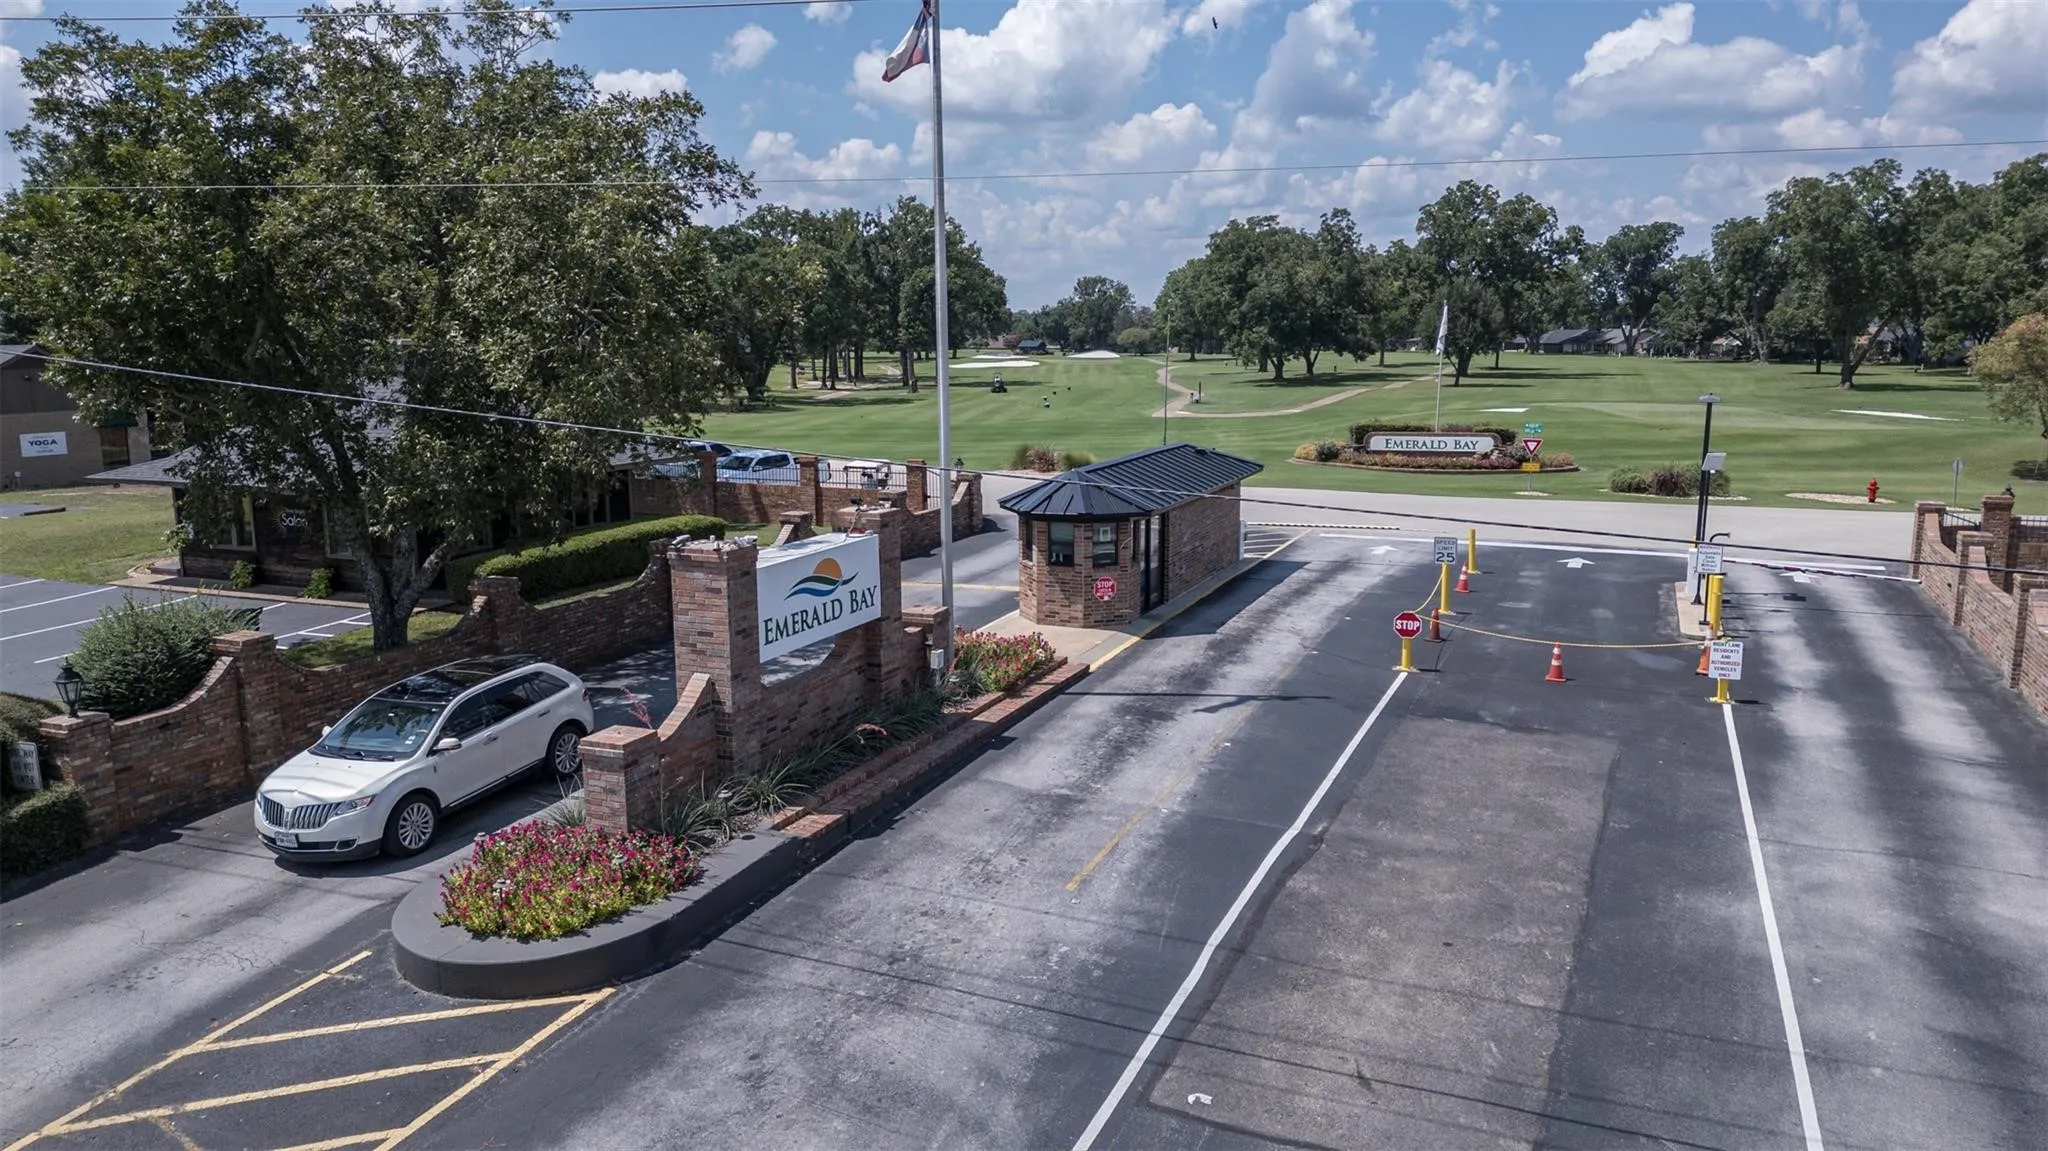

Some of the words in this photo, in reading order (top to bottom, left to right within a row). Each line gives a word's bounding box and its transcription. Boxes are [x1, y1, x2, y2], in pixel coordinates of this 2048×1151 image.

[1385, 438, 1448, 450] EMERALD
[1454, 439, 1479, 450] BAY
[1436, 551, 1455, 562] 25
[1097, 581, 1112, 589] STOP
[763, 598, 843, 646] EMERALD
[849, 585, 878, 614] BAY
[1395, 619, 1420, 630] STOP
